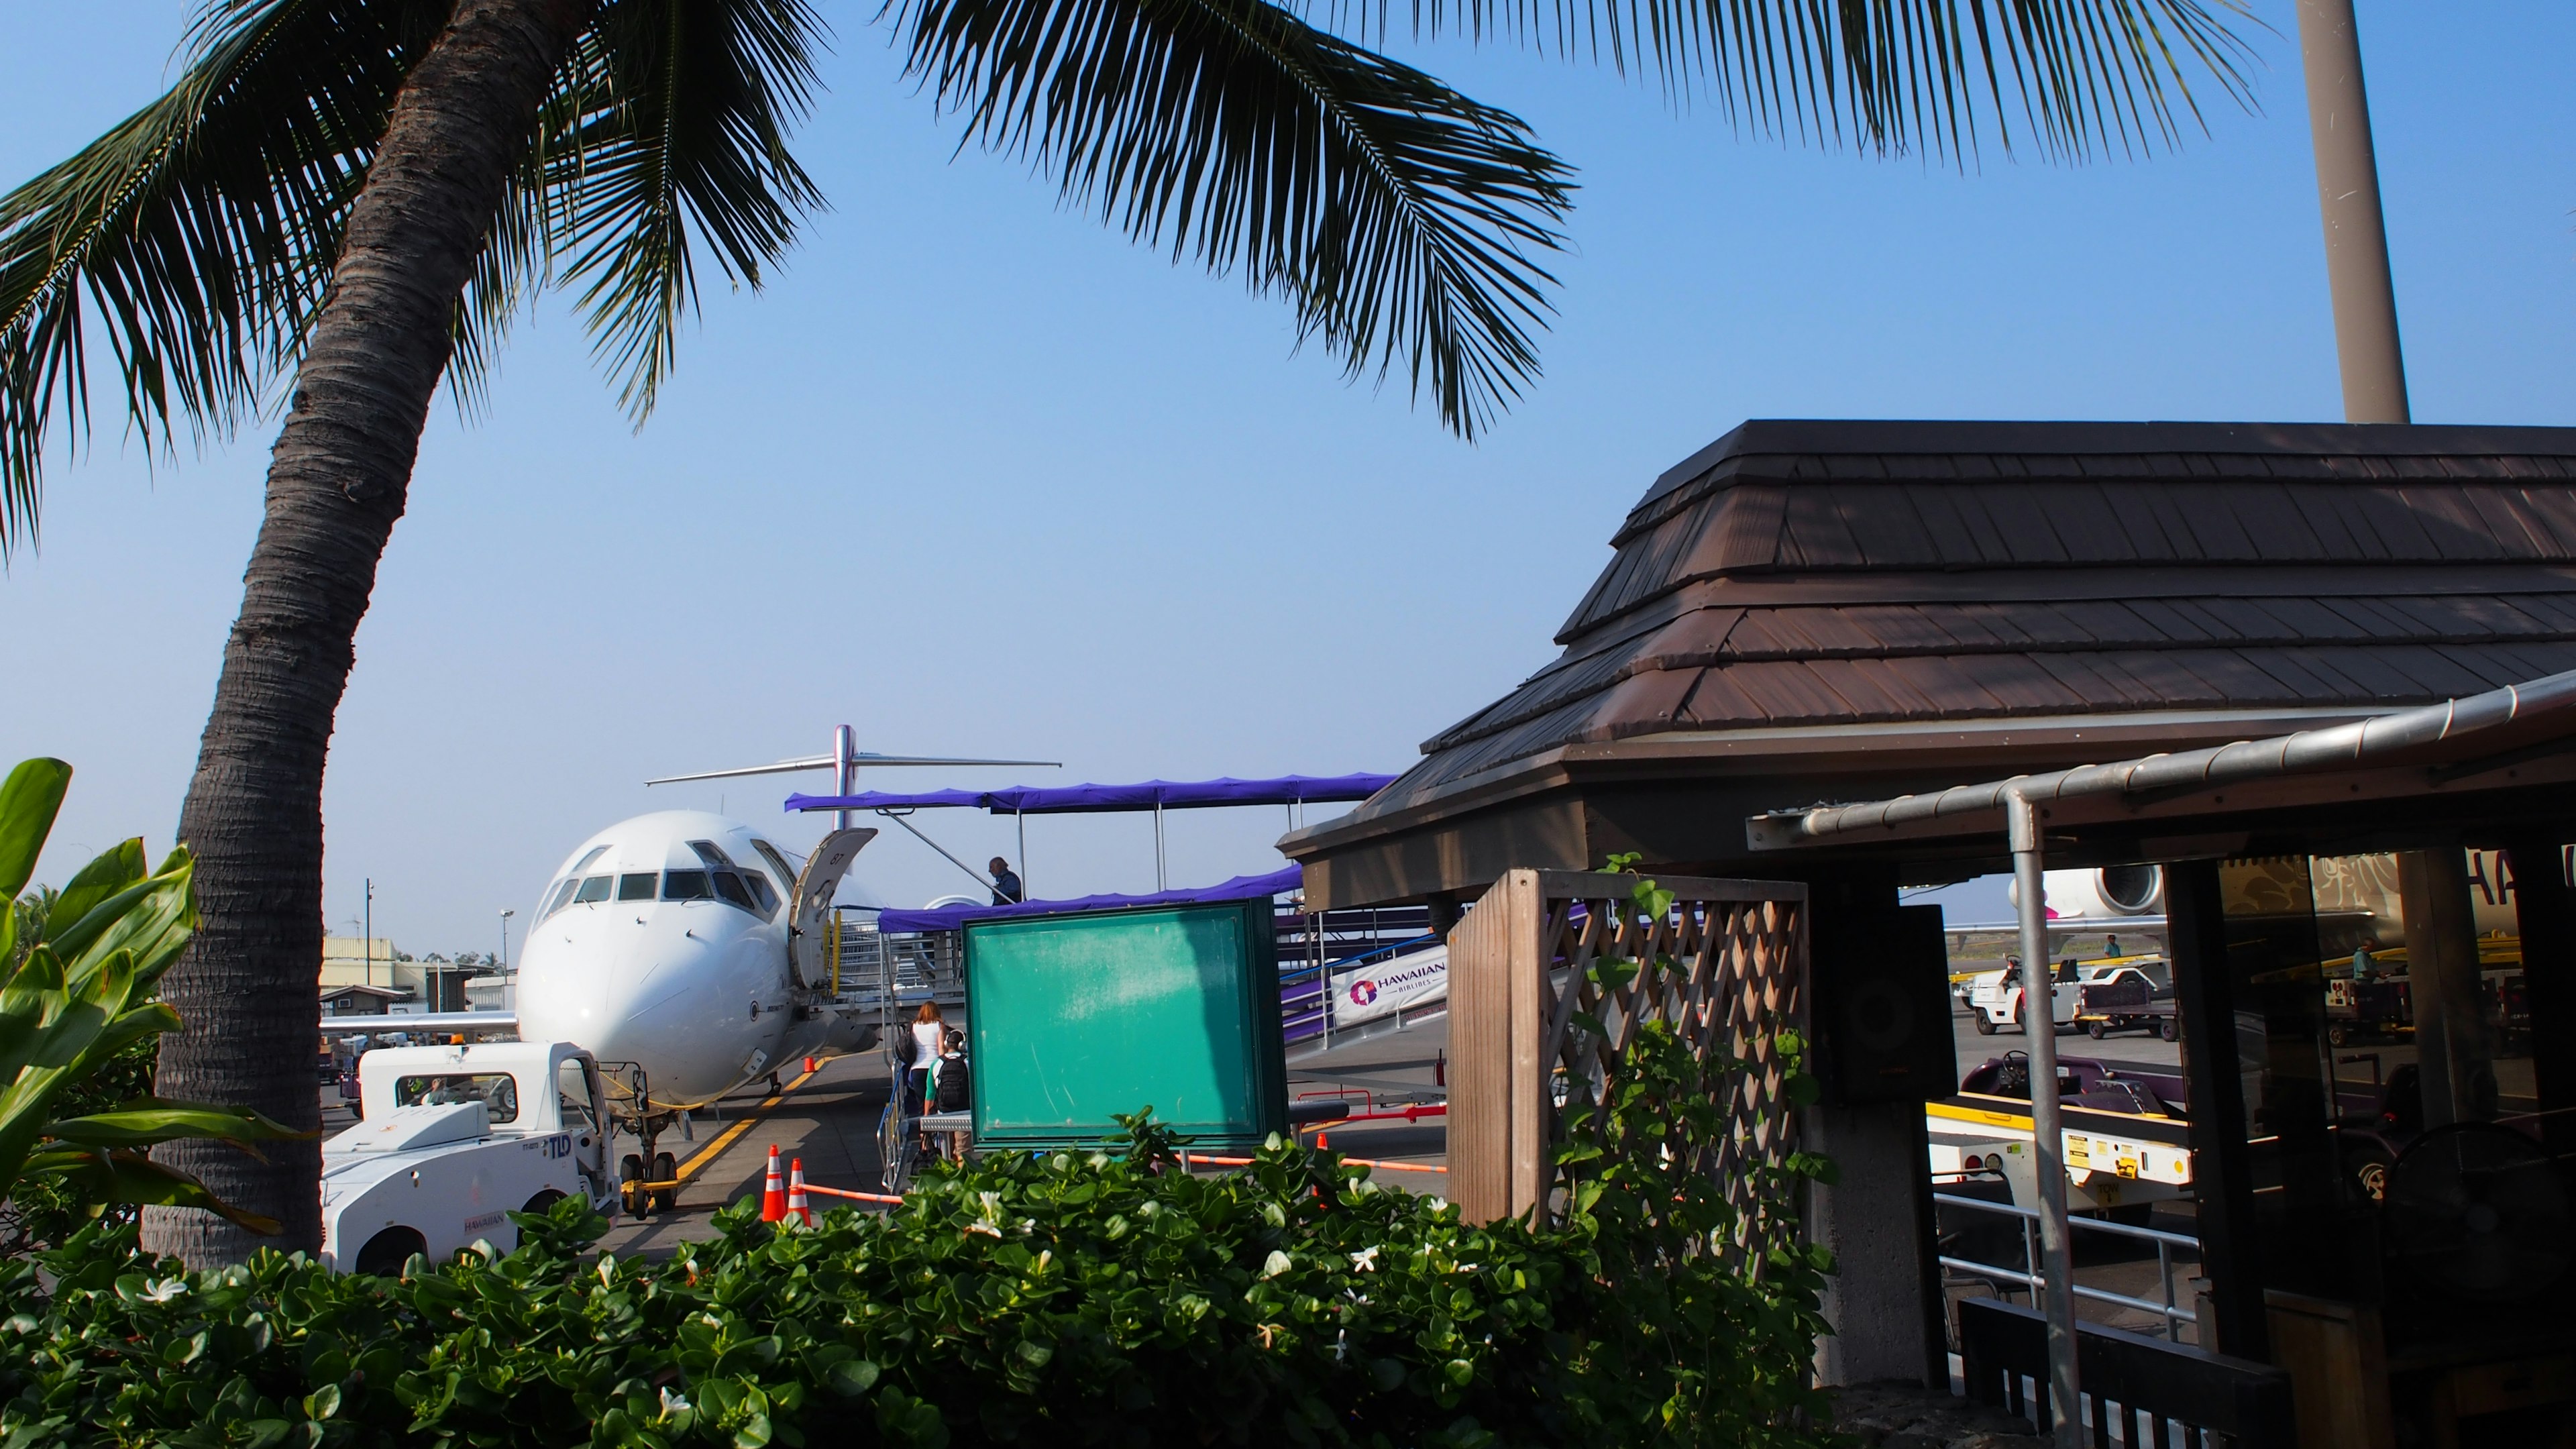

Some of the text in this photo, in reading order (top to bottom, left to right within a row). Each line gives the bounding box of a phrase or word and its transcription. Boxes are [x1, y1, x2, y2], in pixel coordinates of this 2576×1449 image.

[830, 853, 844, 865] 87
[1378, 962, 1446, 988] HAWAIIAN
[1398, 979, 1431, 993] AIRLINES
[549, 1134, 572, 1159] TLD
[2098, 1182, 2119, 1193] TOW
[464, 1214, 504, 1232] HAWAIIAN
